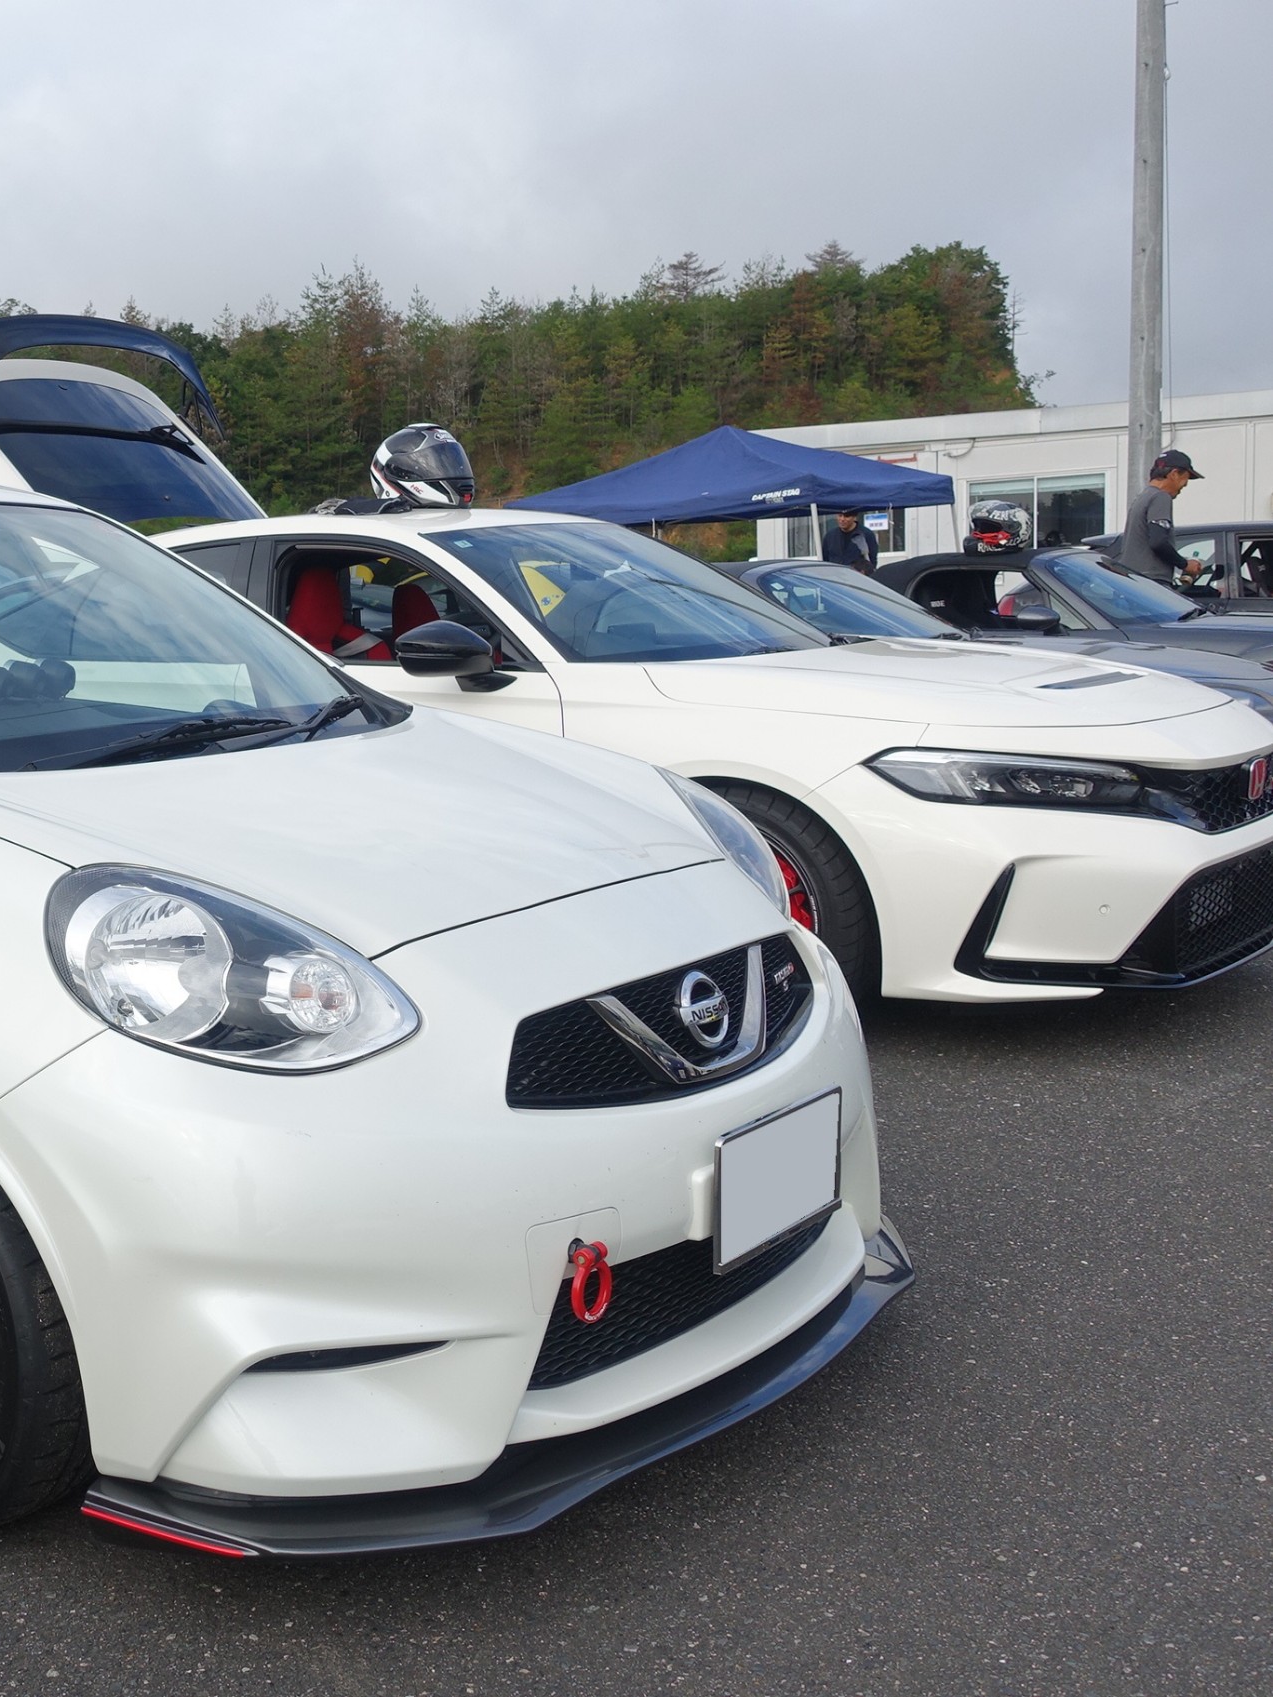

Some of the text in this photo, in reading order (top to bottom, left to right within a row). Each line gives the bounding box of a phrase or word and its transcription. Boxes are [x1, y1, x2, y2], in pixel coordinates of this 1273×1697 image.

[751, 490, 782, 501] CAPTAIN
[782, 488, 800, 497] STAG
[690, 997, 727, 1021] NISSAN
